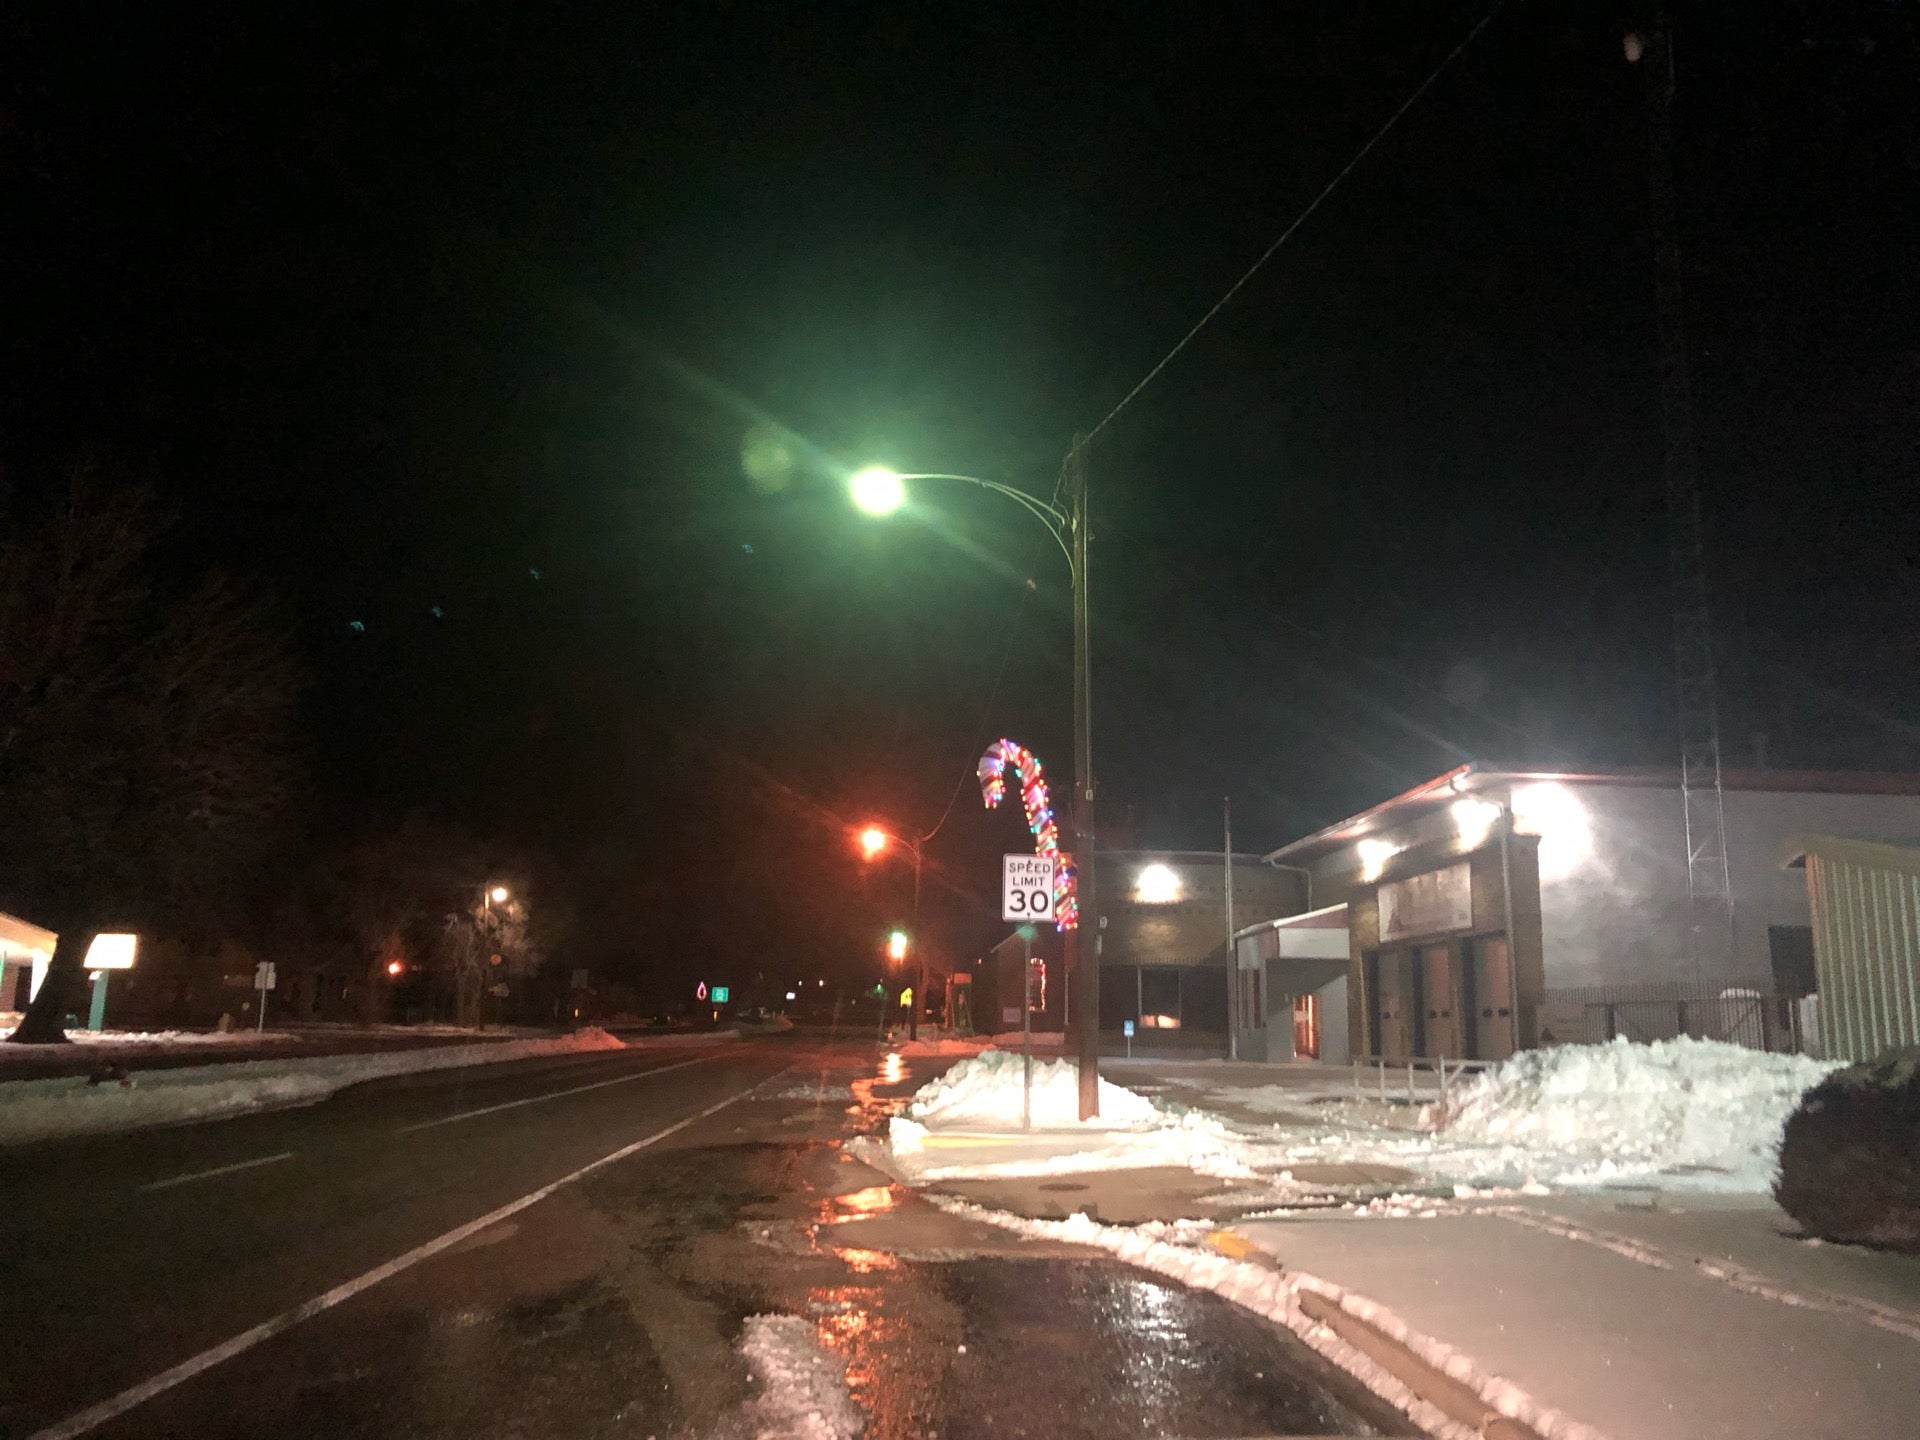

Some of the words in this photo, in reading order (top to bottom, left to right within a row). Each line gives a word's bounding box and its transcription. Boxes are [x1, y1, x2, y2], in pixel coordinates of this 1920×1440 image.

[1009, 862, 1051, 873] SPEED
[1012, 876, 1045, 887] LIMIT
[1009, 889, 1049, 913] 30
